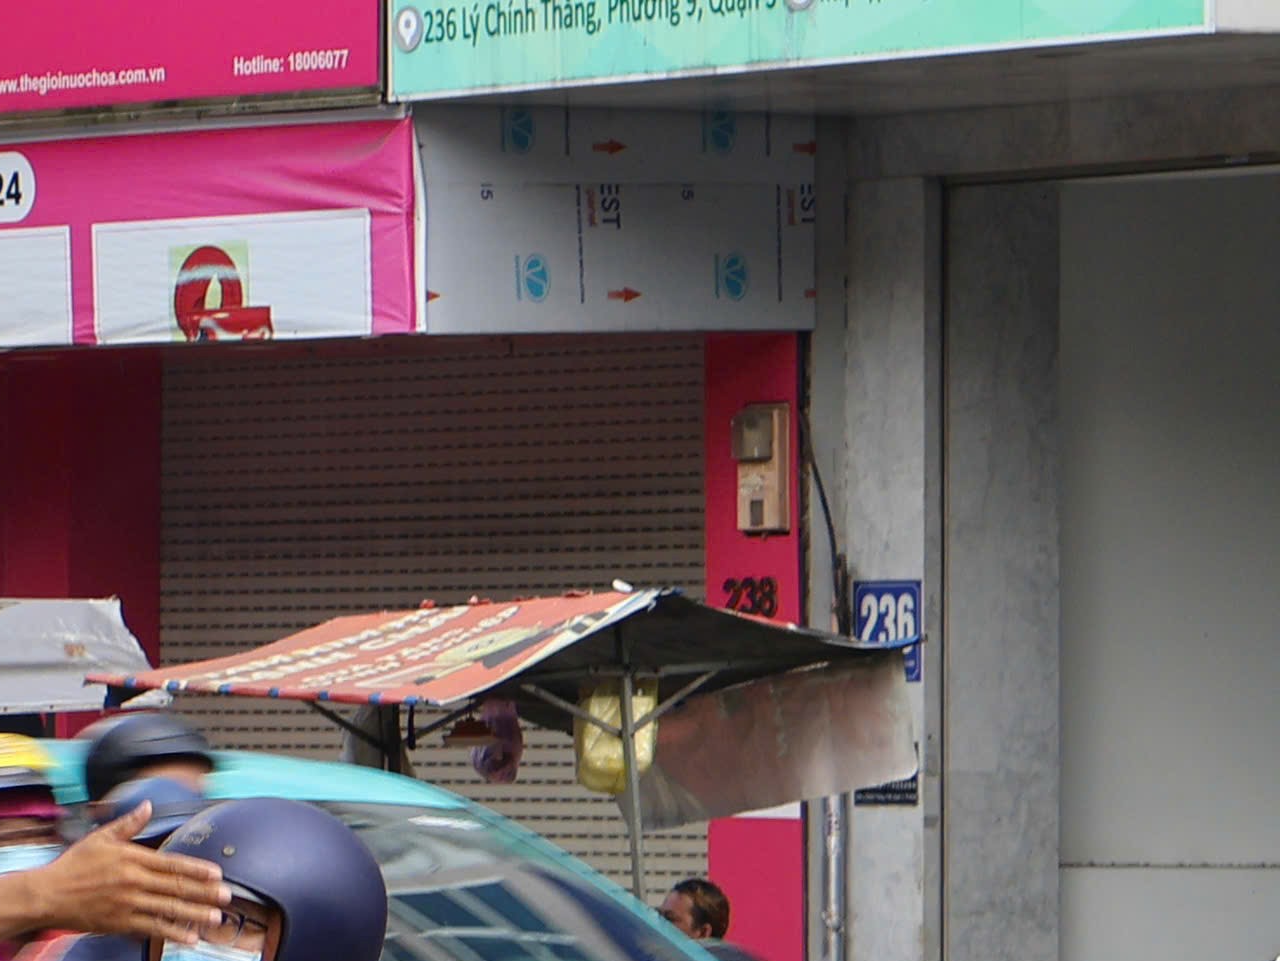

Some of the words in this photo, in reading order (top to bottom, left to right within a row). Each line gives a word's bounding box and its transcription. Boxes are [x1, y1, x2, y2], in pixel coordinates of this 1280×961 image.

[423, 10, 457, 43] 236
[462, 4, 480, 47] Lý
[485, 0, 535, 36] Chính
[233, 55, 284, 76] Hotline:
[288, 48, 349, 72] 18006077
[723, 577, 778, 618] 238
[860, 592, 915, 646] 236
